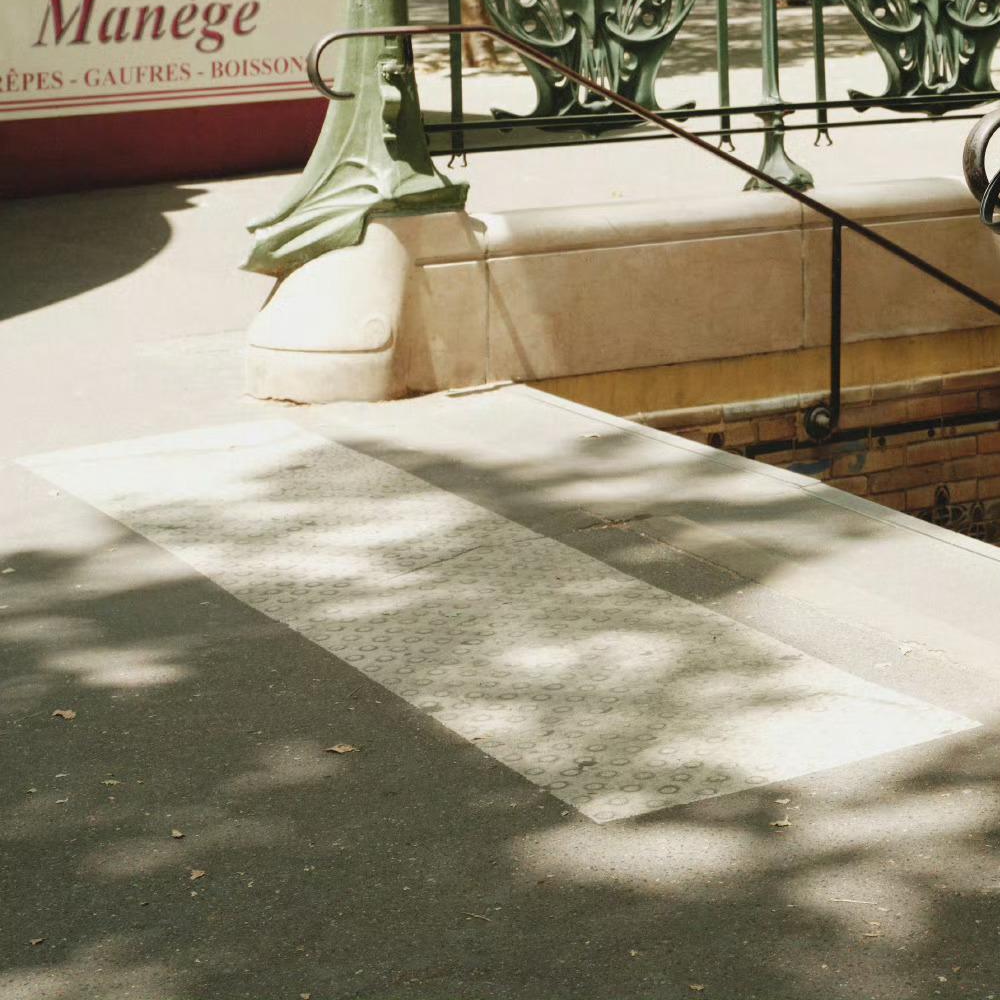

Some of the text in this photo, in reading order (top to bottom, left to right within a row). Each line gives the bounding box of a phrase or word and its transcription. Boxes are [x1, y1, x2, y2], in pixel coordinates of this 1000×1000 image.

[0, 67, 64, 92] ÊPES
[84, 62, 191, 88] GAUFRES
[211, 55, 307, 79] BOISSON
